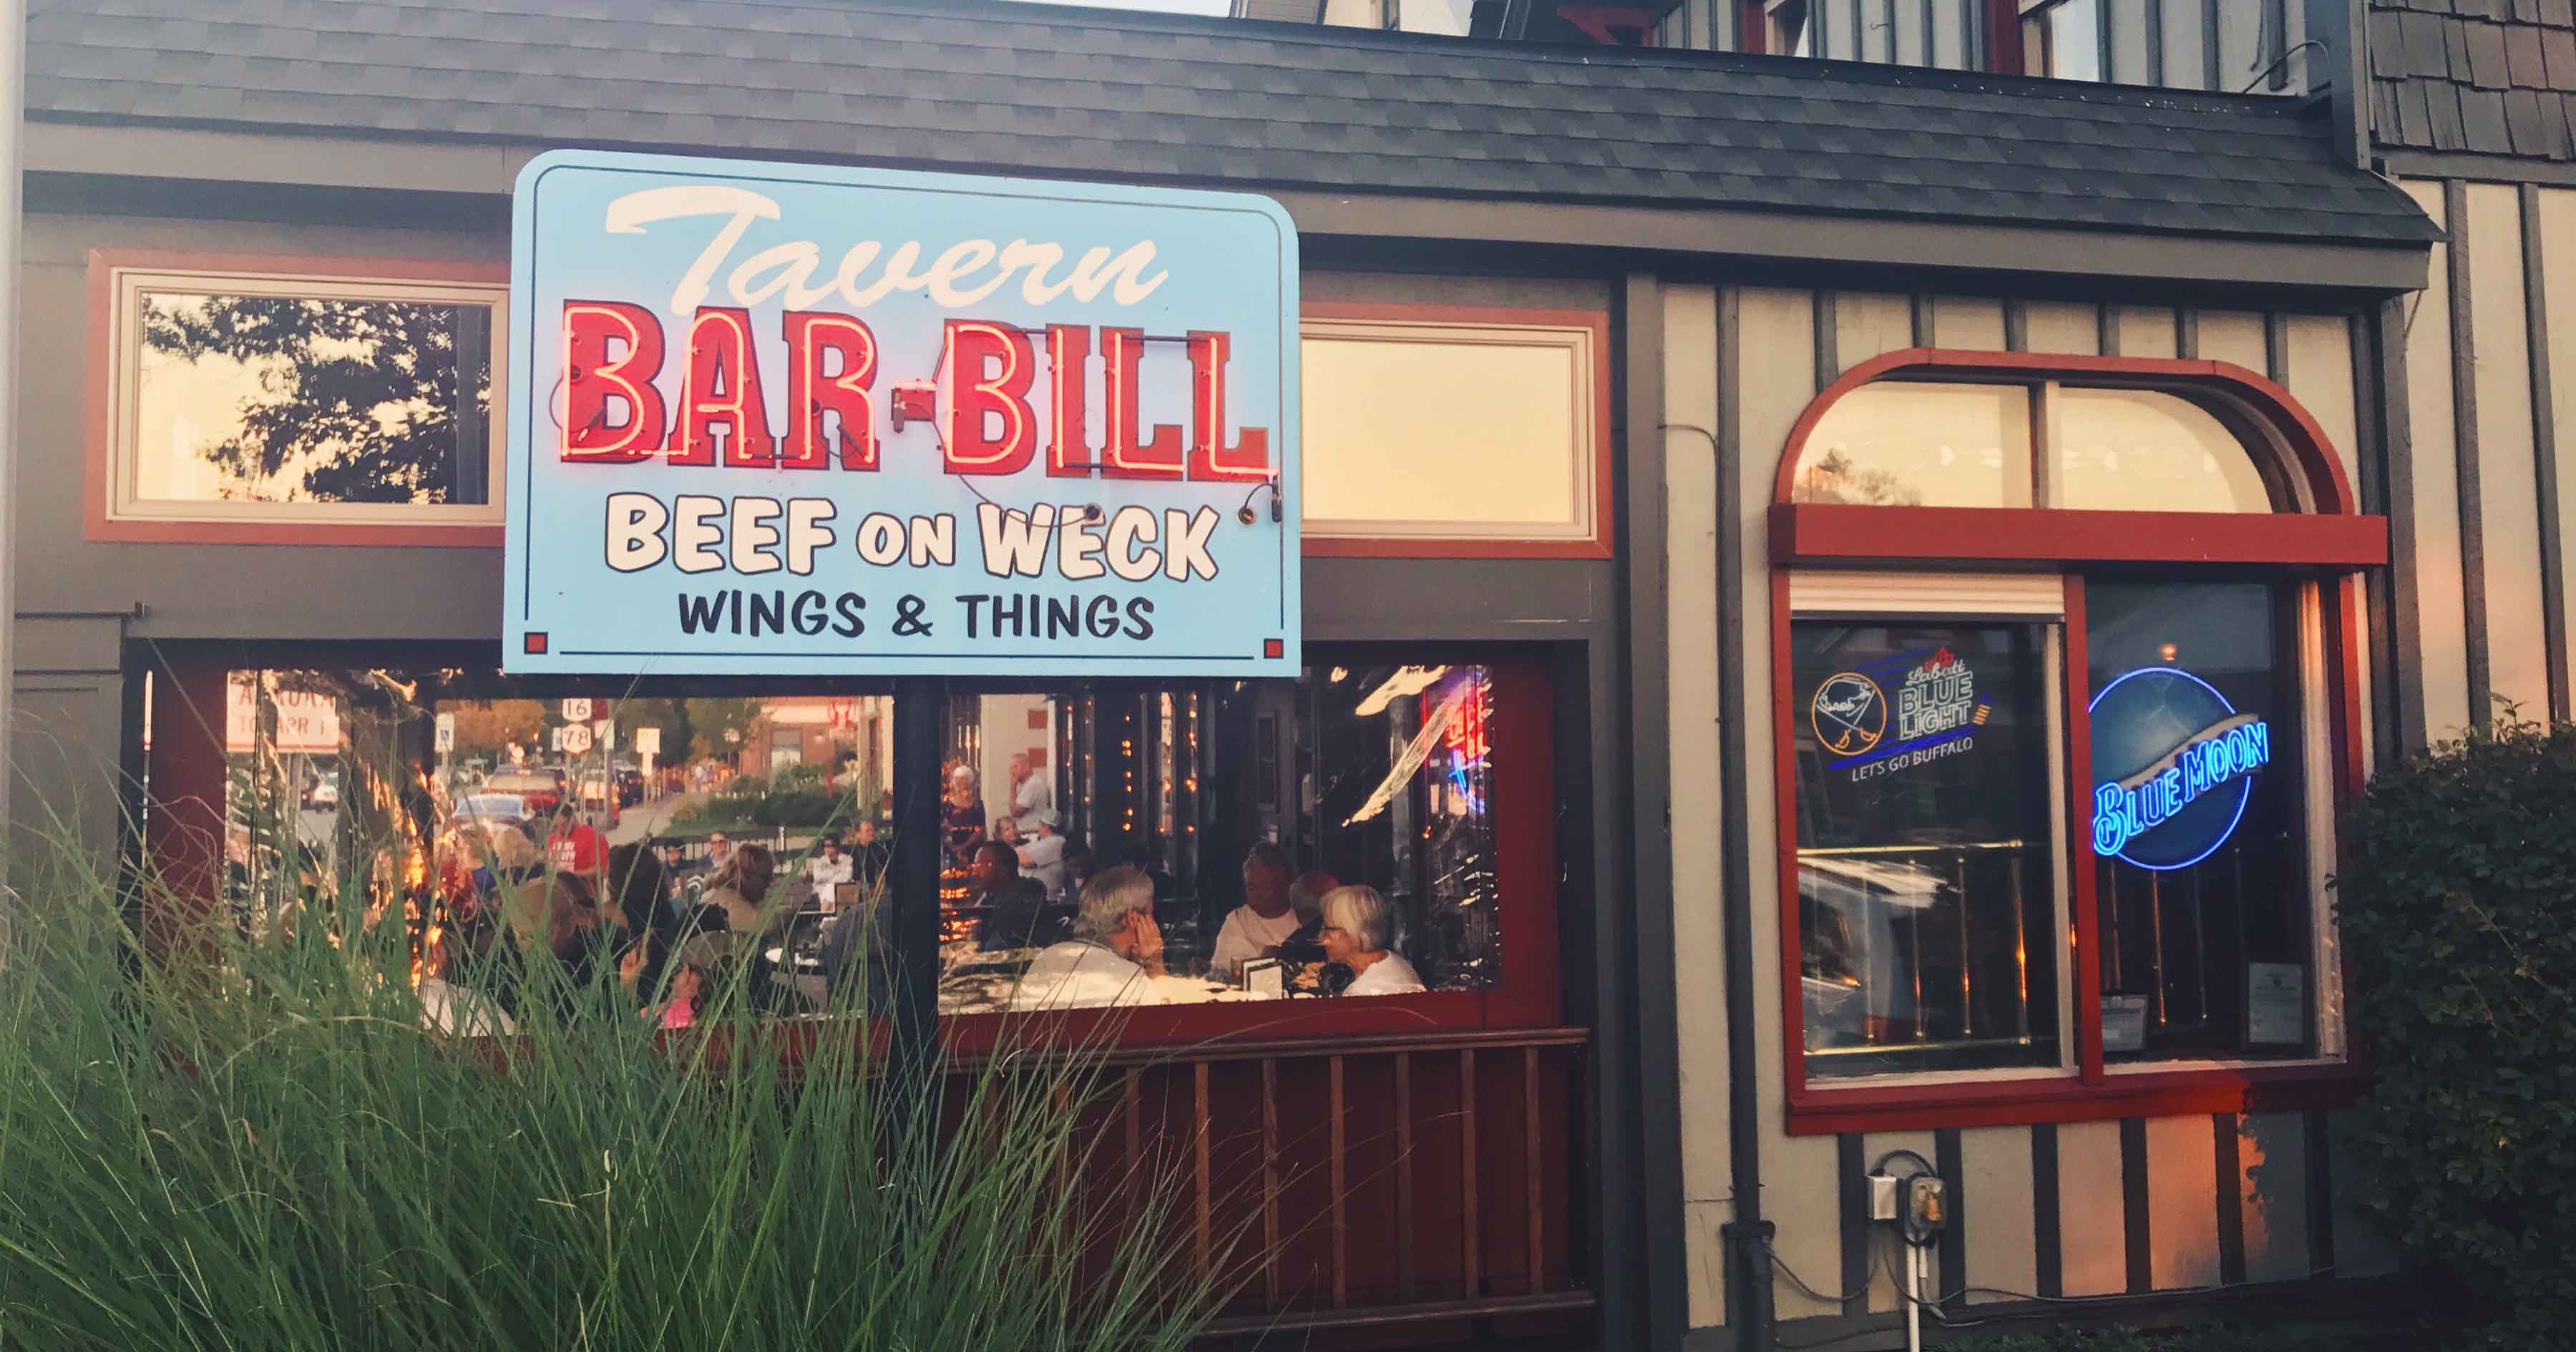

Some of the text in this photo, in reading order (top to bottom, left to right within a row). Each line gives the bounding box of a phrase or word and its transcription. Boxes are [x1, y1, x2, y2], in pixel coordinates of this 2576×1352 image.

[605, 185, 1170, 316] Tavern
[560, 298, 1278, 484] BAR-BILL
[605, 491, 1221, 582] BEEF ON WECK
[678, 590, 1155, 642] WINGS & THINGS
[1898, 670, 1973, 716] BLUE
[1906, 660, 1966, 686] Labatt
[567, 700, 587, 716] 16
[1899, 700, 1973, 741] LIGHT
[564, 730, 589, 746] 78
[1888, 755, 1909, 772] GO
[1913, 736, 1974, 765] BUFFALO
[2093, 720, 2270, 856] BLUE MOON
